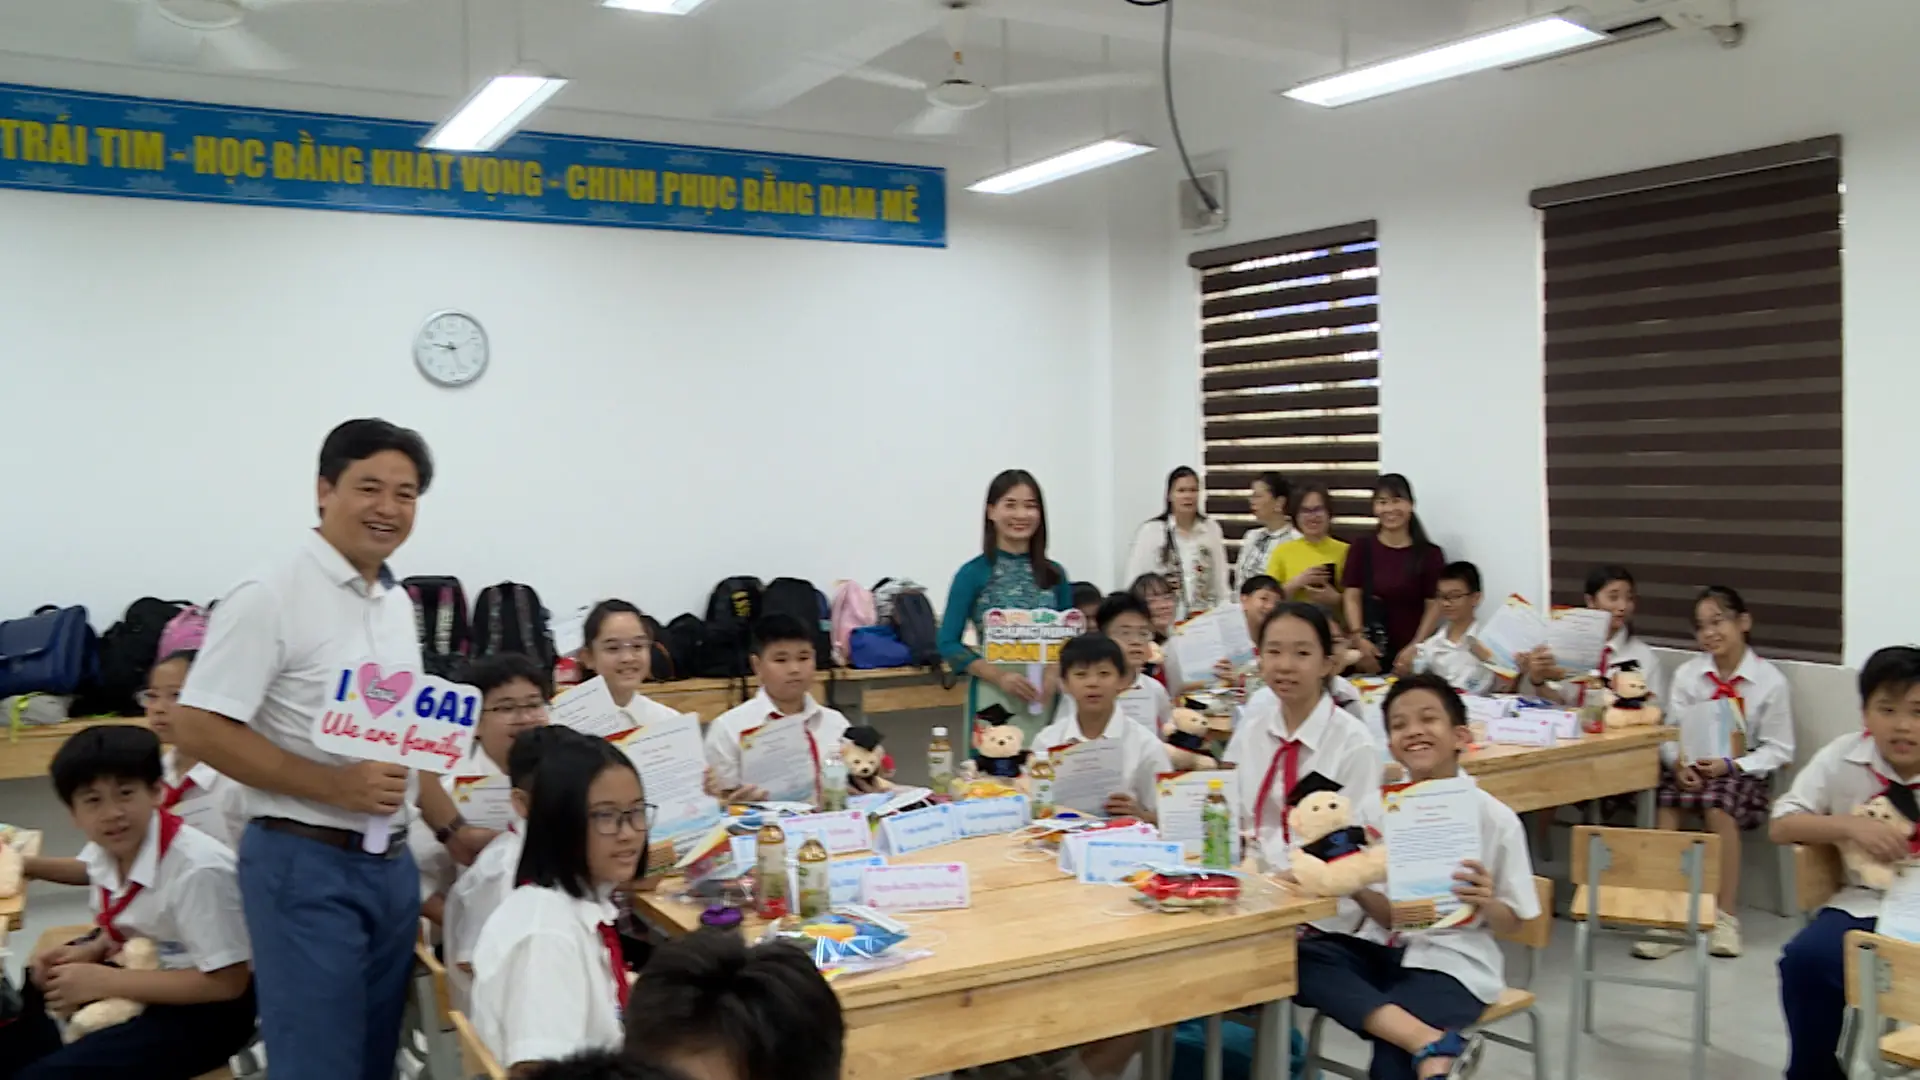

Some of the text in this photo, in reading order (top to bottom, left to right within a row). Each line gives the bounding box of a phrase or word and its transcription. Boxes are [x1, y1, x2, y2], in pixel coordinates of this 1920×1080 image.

[0, 113, 88, 165] TRÁI
[95, 127, 165, 170] TIM
[194, 135, 266, 184] HỌC
[460, 156, 543, 201] VỌNG
[567, 164, 656, 204] CHINH
[662, 171, 737, 215] PHỤC
[882, 184, 920, 223] MÊ
[334, 669, 352, 702] I
[414, 686, 477, 726] 6A1
[320, 710, 467, 770] We are family
